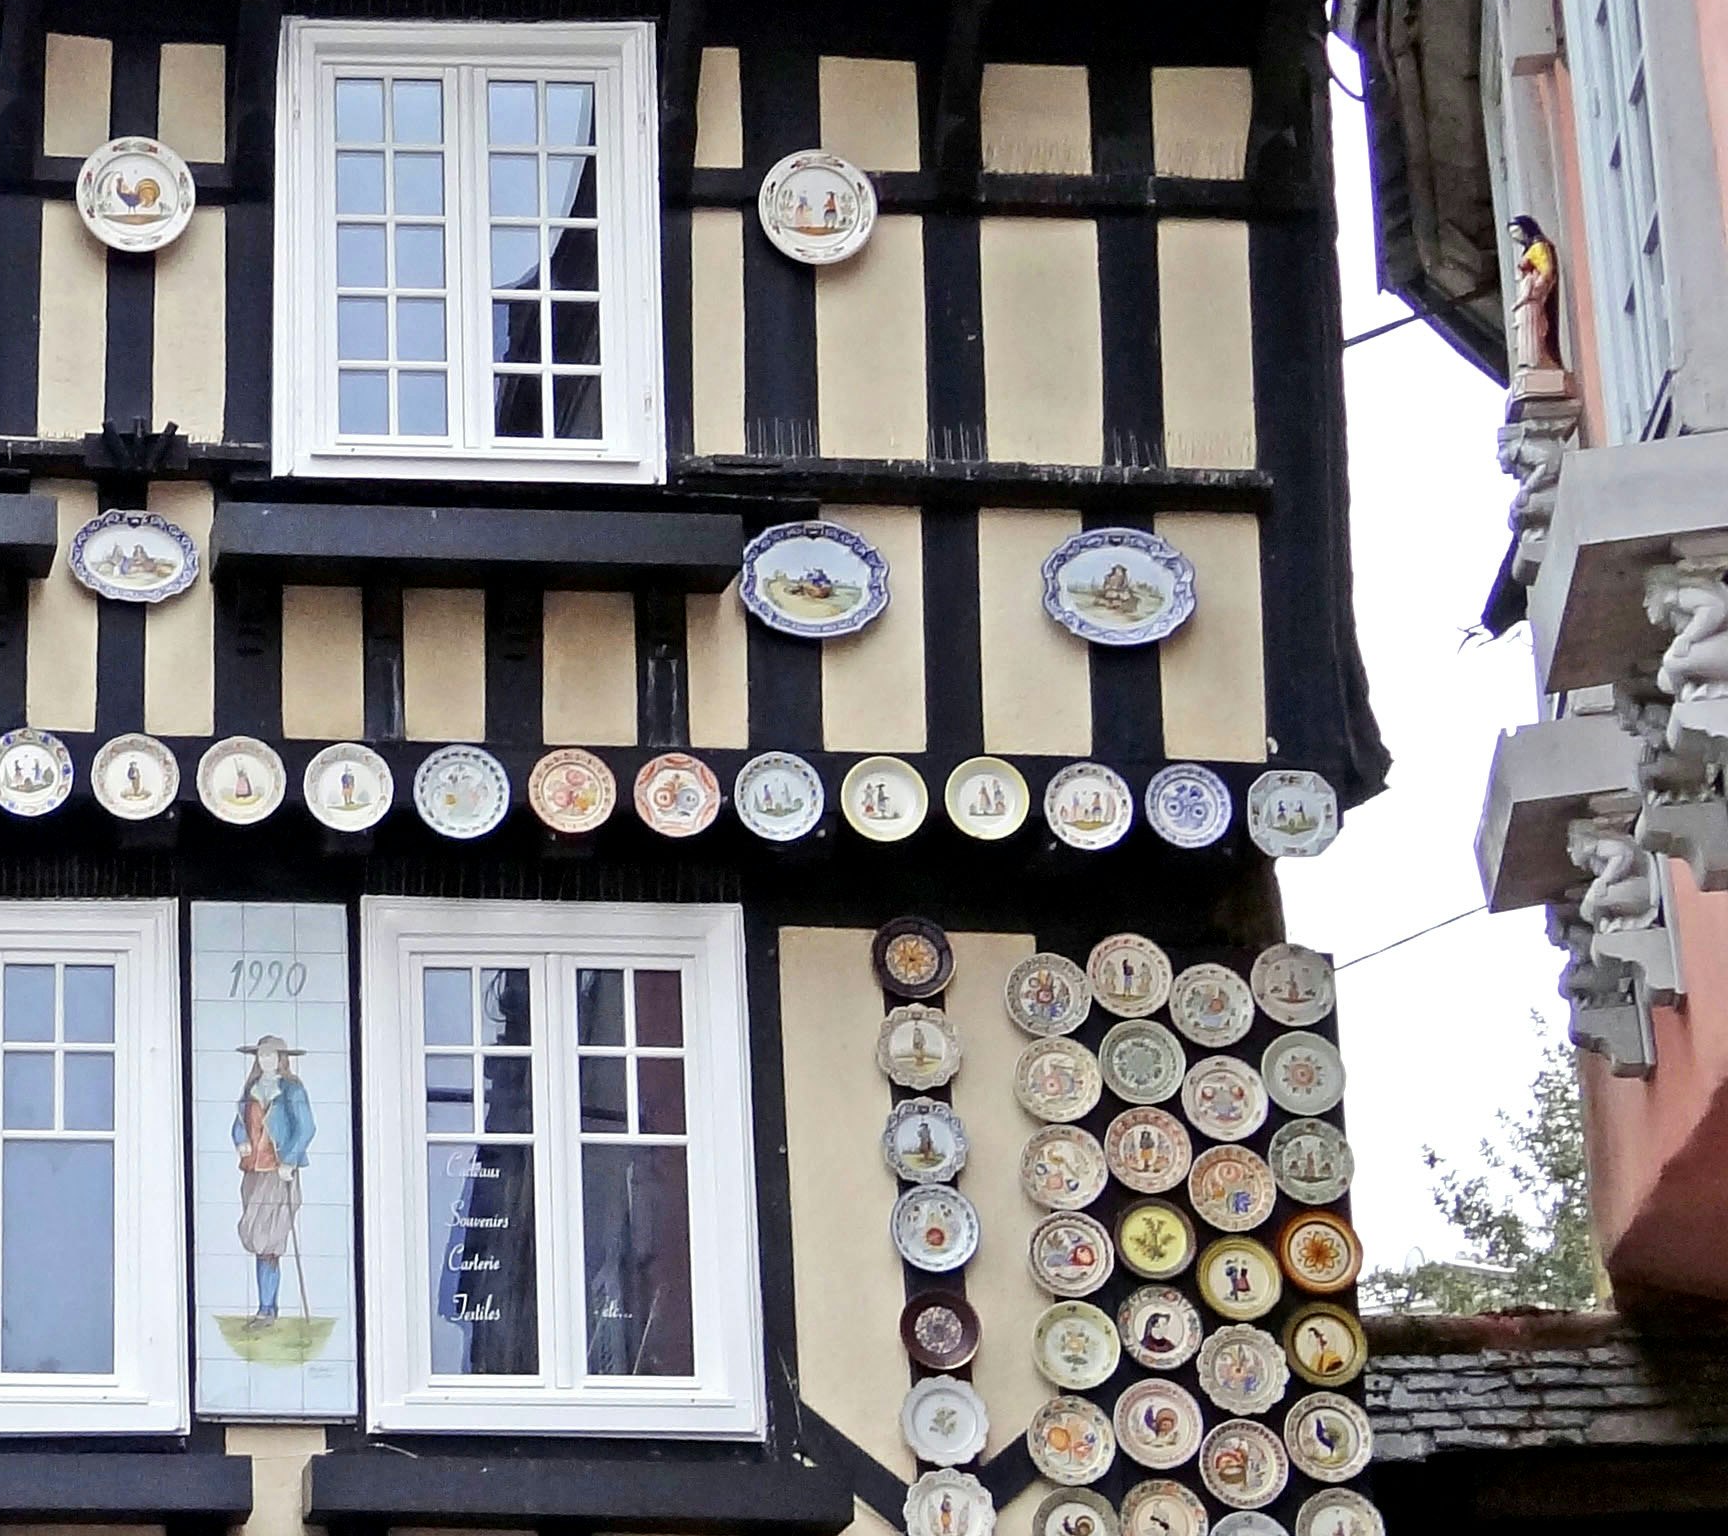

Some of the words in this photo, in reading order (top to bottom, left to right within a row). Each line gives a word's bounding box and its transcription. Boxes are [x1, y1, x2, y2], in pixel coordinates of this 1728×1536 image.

[228, 959, 307, 998] 1990
[445, 1199, 509, 1229] Souvenirs
[448, 1244, 501, 1272] Carterie
[450, 1293, 501, 1323] Textiles
